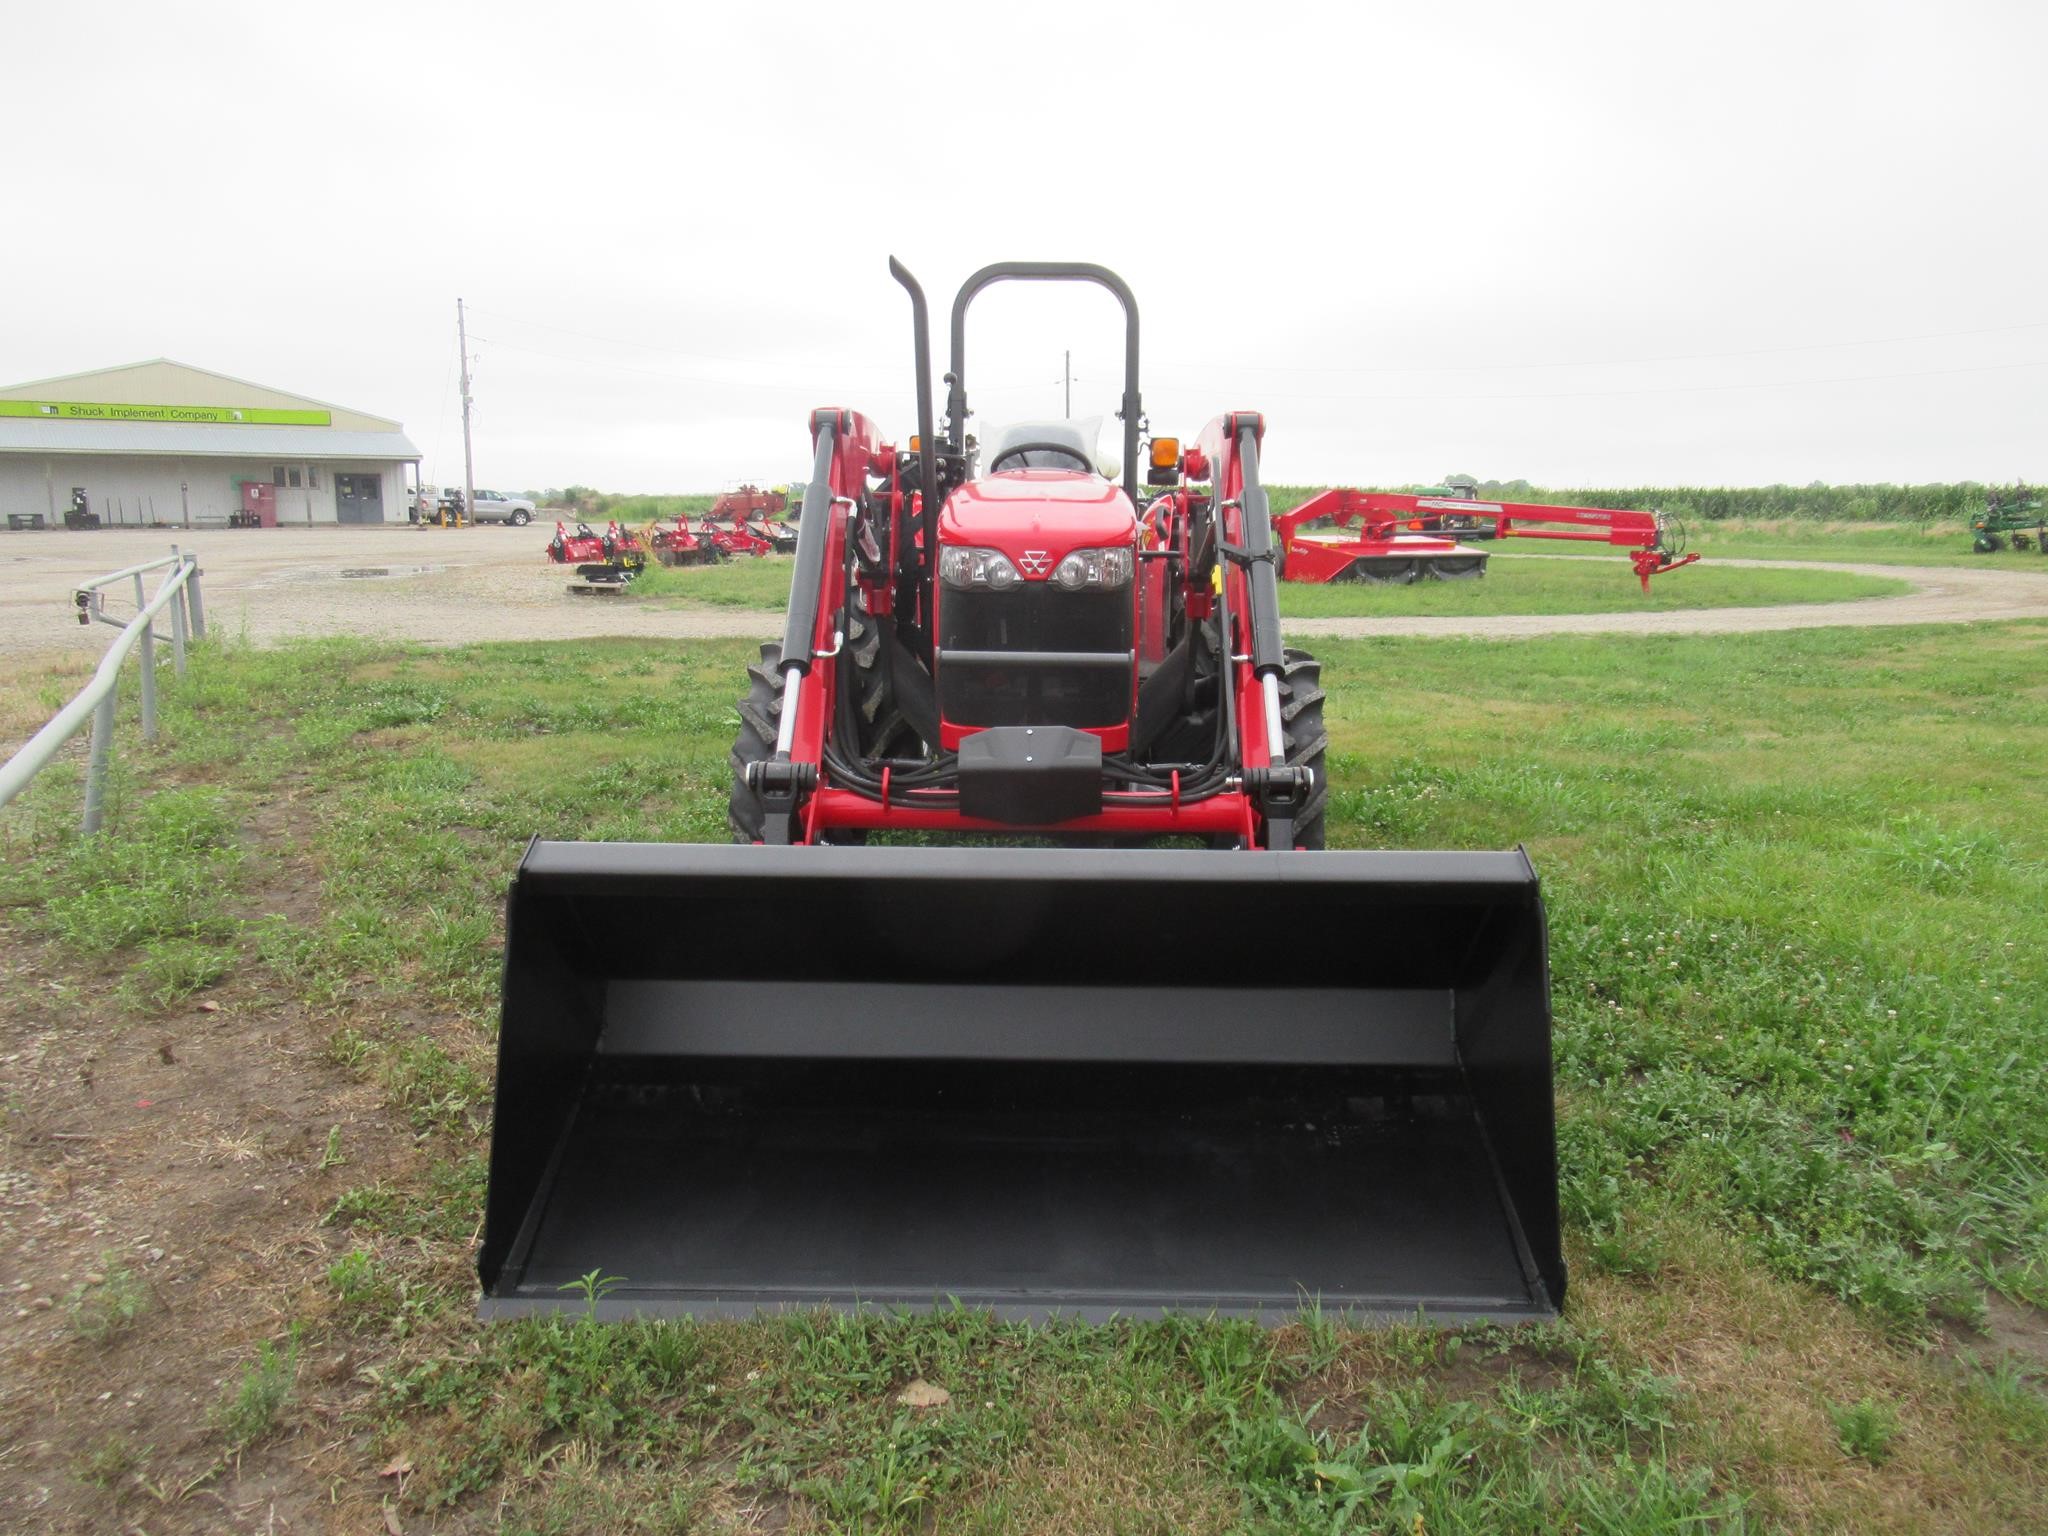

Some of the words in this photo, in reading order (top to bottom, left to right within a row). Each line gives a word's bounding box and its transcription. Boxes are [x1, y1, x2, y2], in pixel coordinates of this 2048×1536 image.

[70, 406, 104, 416] Shuck
[110, 408, 165, 419] Implement
[170, 409, 218, 421] Company
